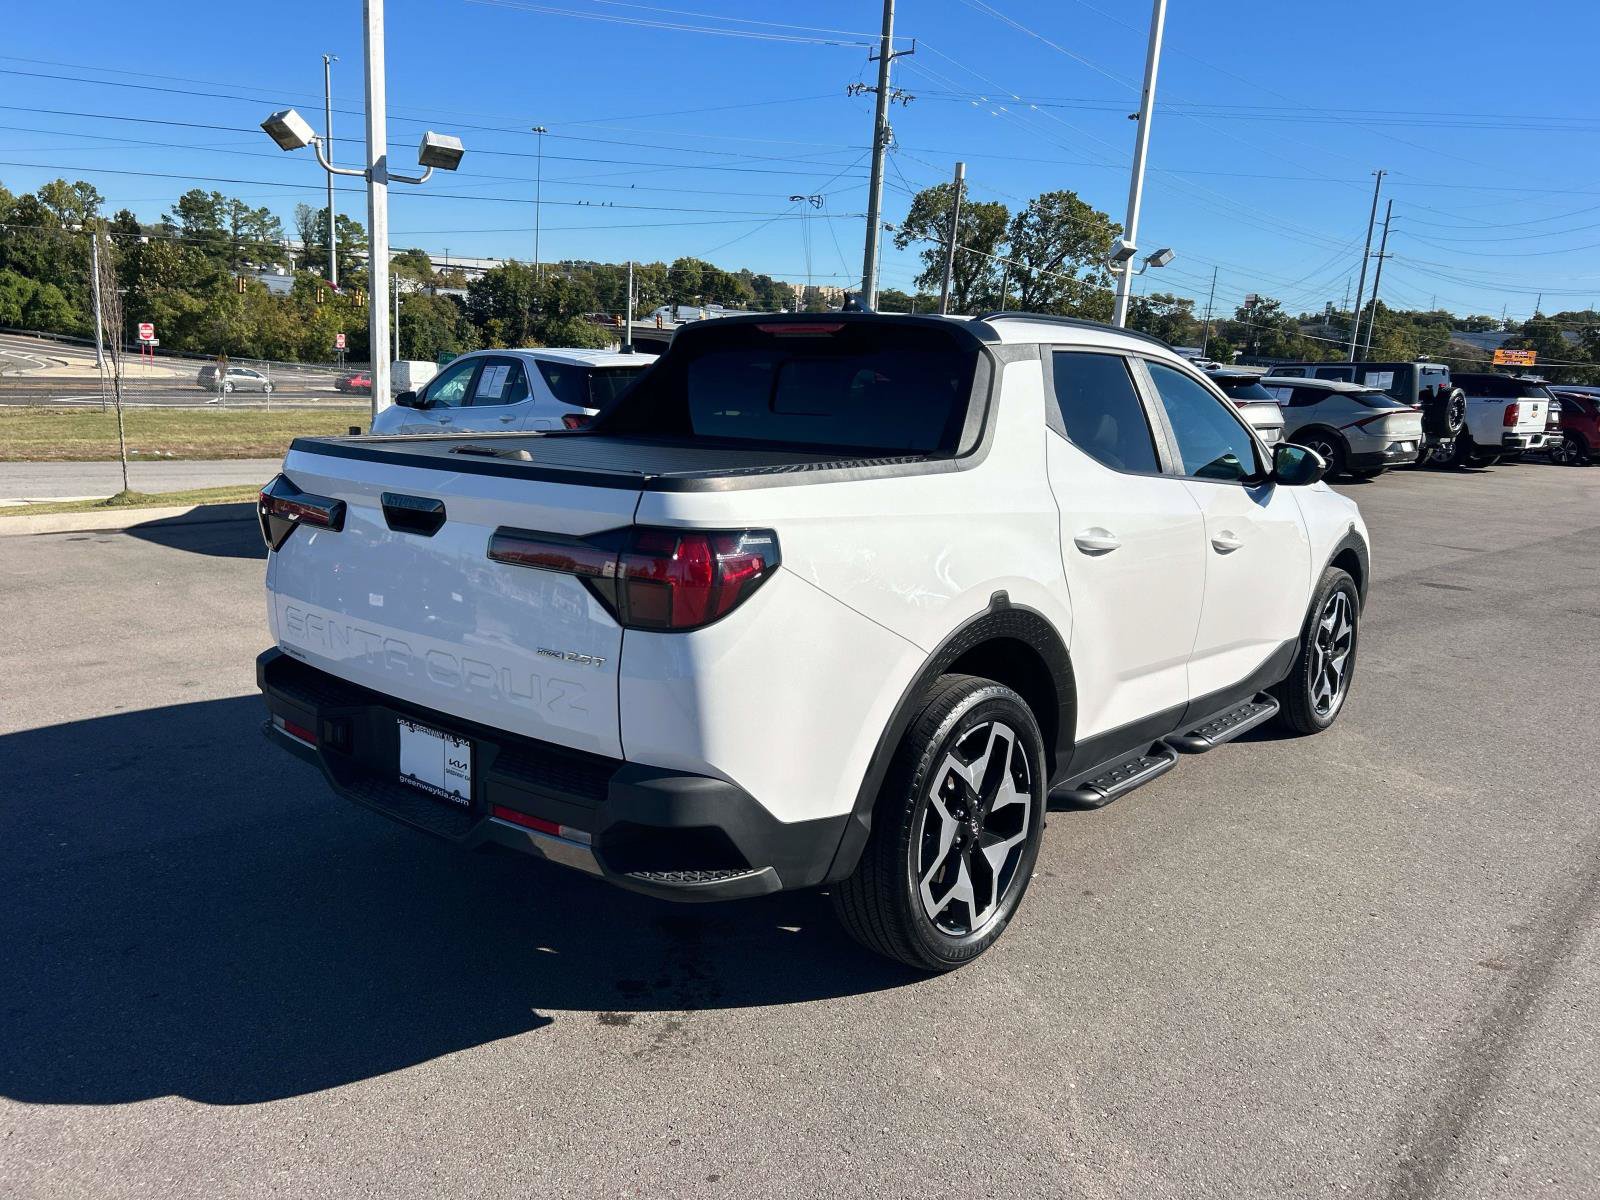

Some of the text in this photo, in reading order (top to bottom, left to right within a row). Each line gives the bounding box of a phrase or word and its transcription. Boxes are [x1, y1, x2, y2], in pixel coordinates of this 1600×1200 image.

[286, 605, 588, 716] SANTA CRUZ
[399, 775, 470, 806] greenwaykia.com
